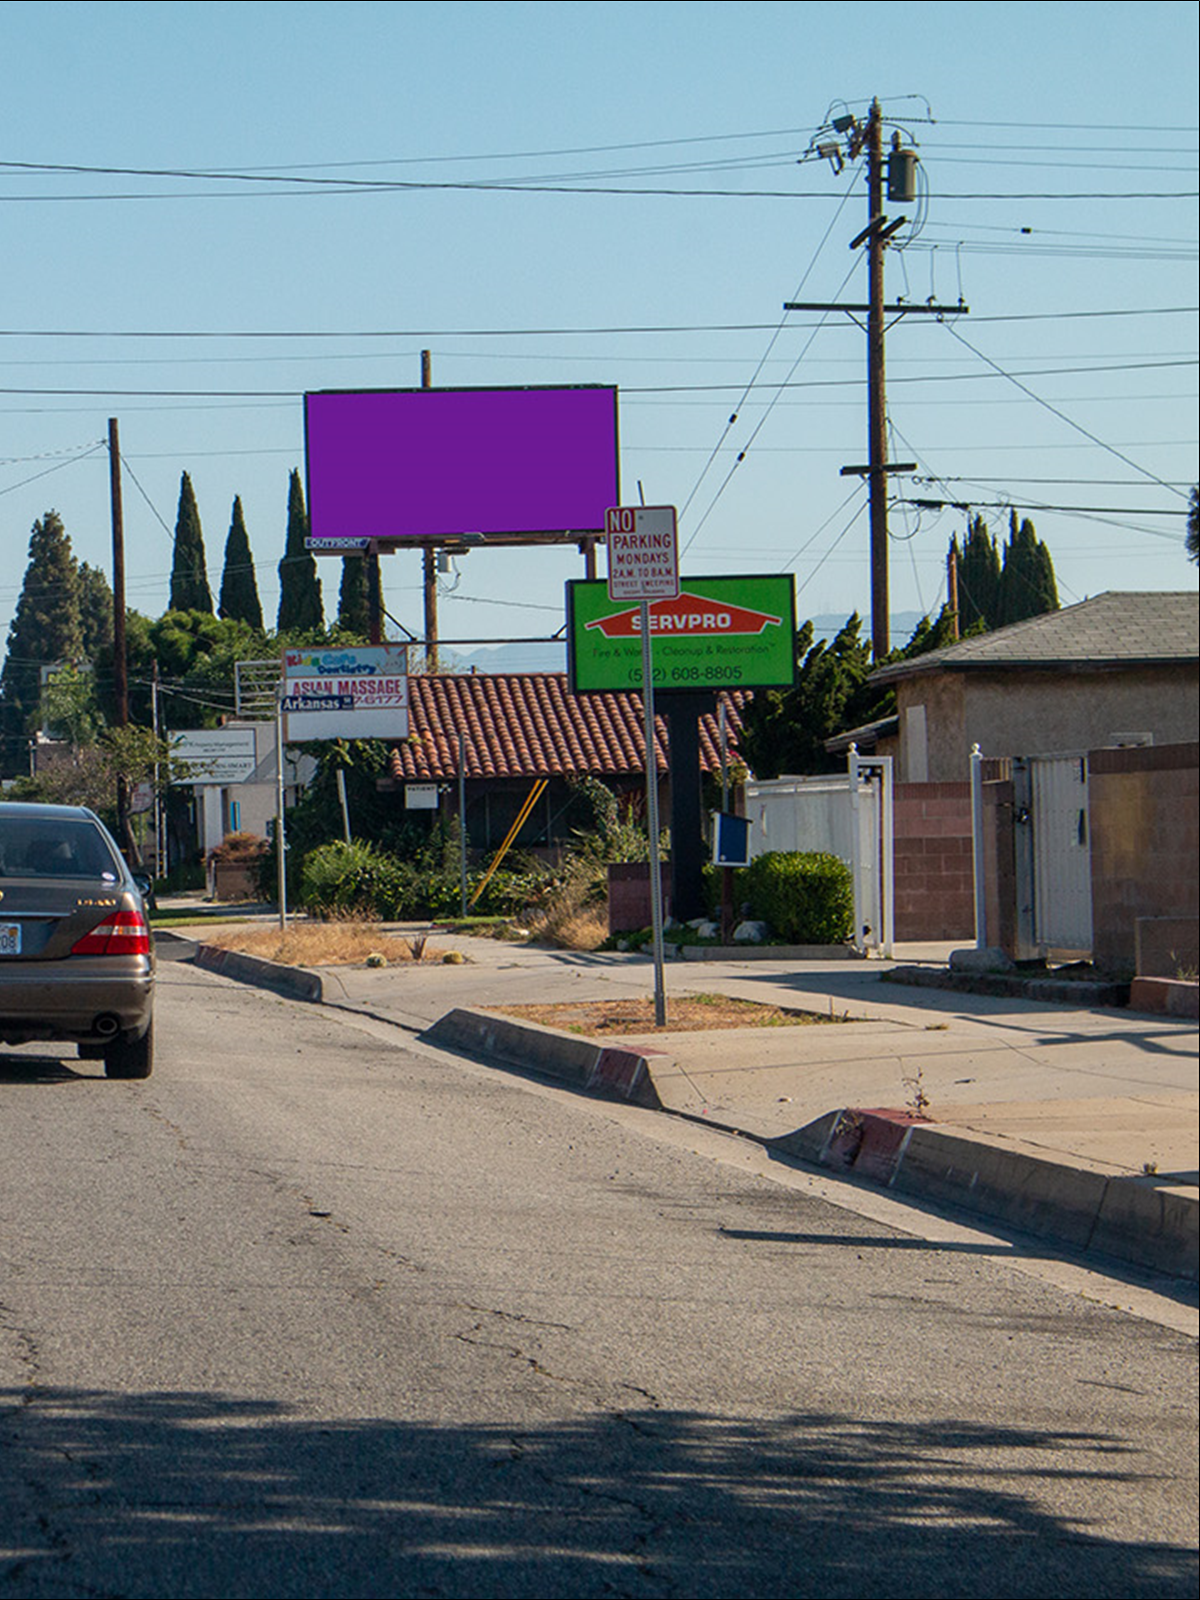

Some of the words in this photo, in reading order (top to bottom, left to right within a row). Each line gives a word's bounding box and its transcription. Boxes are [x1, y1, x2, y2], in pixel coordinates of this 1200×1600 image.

[610, 509, 632, 532] NO
[613, 533, 671, 549] PARKING
[617, 552, 669, 565] MONDAYS
[638, 568, 649, 578] TO
[631, 613, 732, 631] SERVPRO
[593, 647, 611, 658] Fire
[662, 645, 704, 658] Cleanup
[286, 653, 320, 668] Kids
[317, 663, 377, 675] Dentistry
[628, 668, 666, 682] (52)
[671, 665, 742, 681] 608-8805
[293, 681, 333, 695] ASIAN
[337, 679, 401, 695] MASSAGE
[283, 696, 340, 710] Arkansas
